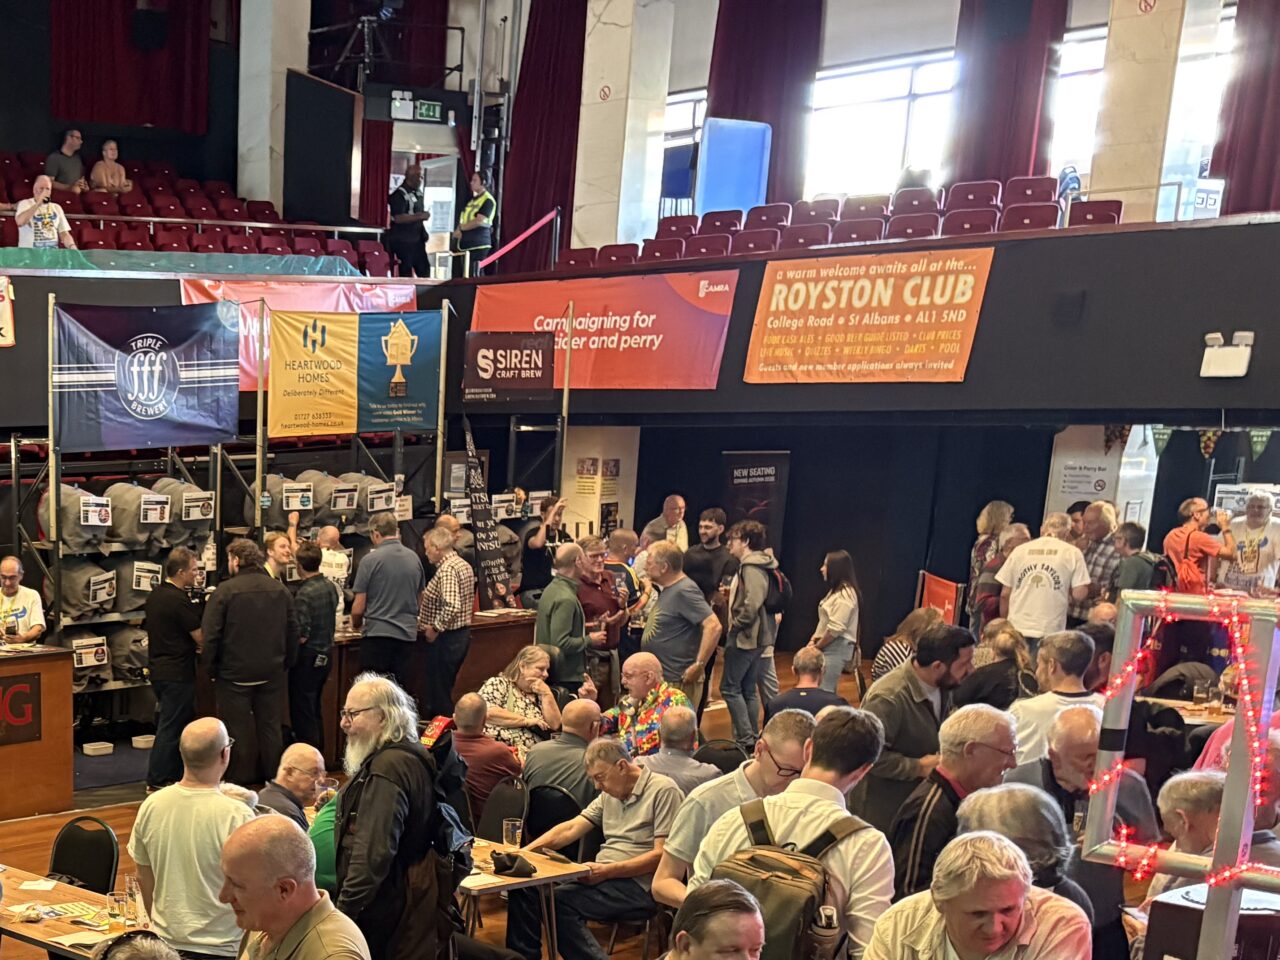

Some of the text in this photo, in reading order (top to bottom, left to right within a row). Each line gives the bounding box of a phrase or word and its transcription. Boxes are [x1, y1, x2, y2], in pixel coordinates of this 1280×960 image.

[777, 258, 977, 280] a warm welcome awaits all at the...
[704, 284, 729, 293] CAMRA
[770, 274, 975, 311] ROYSTON CLUB
[633, 311, 656, 327] for
[767, 309, 967, 330] College Road St Albans AL1 5ND
[130, 338, 162, 350] TRIPLE
[589, 333, 617, 348] and
[619, 333, 663, 351] perry
[939, 342, 960, 354] POOL
[496, 349, 543, 368] SIREN
[284, 360, 342, 370] HEARTWOOD
[298, 374, 329, 383] HOMES
[496, 370, 542, 378] CRAFT BREW
[283, 389, 317, 397] Deliberately
[131, 398, 168, 415] BREWERY
[733, 467, 775, 477] NEW SEATING
